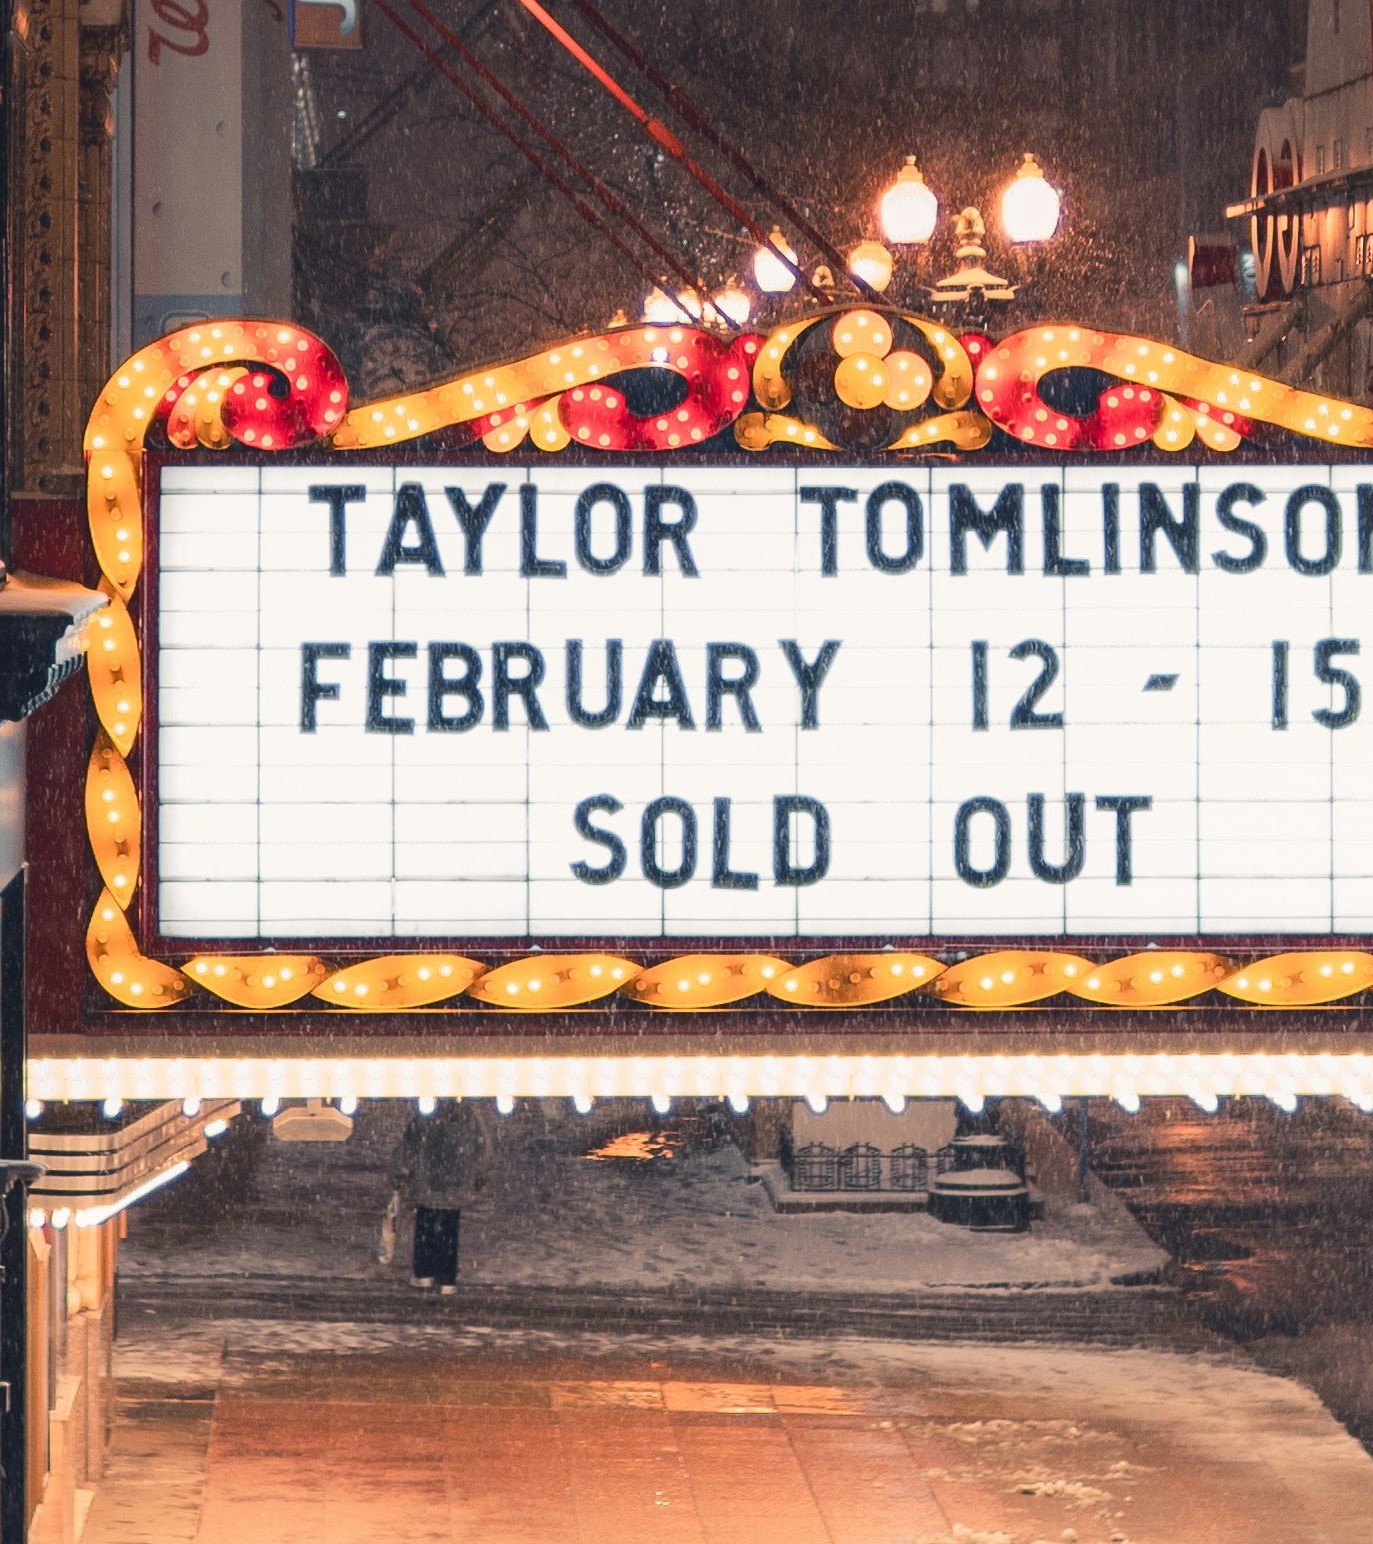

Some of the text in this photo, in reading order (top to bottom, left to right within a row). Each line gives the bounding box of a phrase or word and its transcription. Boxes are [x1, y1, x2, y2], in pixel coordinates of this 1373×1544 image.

[308, 481, 698, 577] TAYLOR
[300, 637, 1362, 734] FEBRUARY 12 - 15
[568, 791, 1154, 889] SOLD OUT
